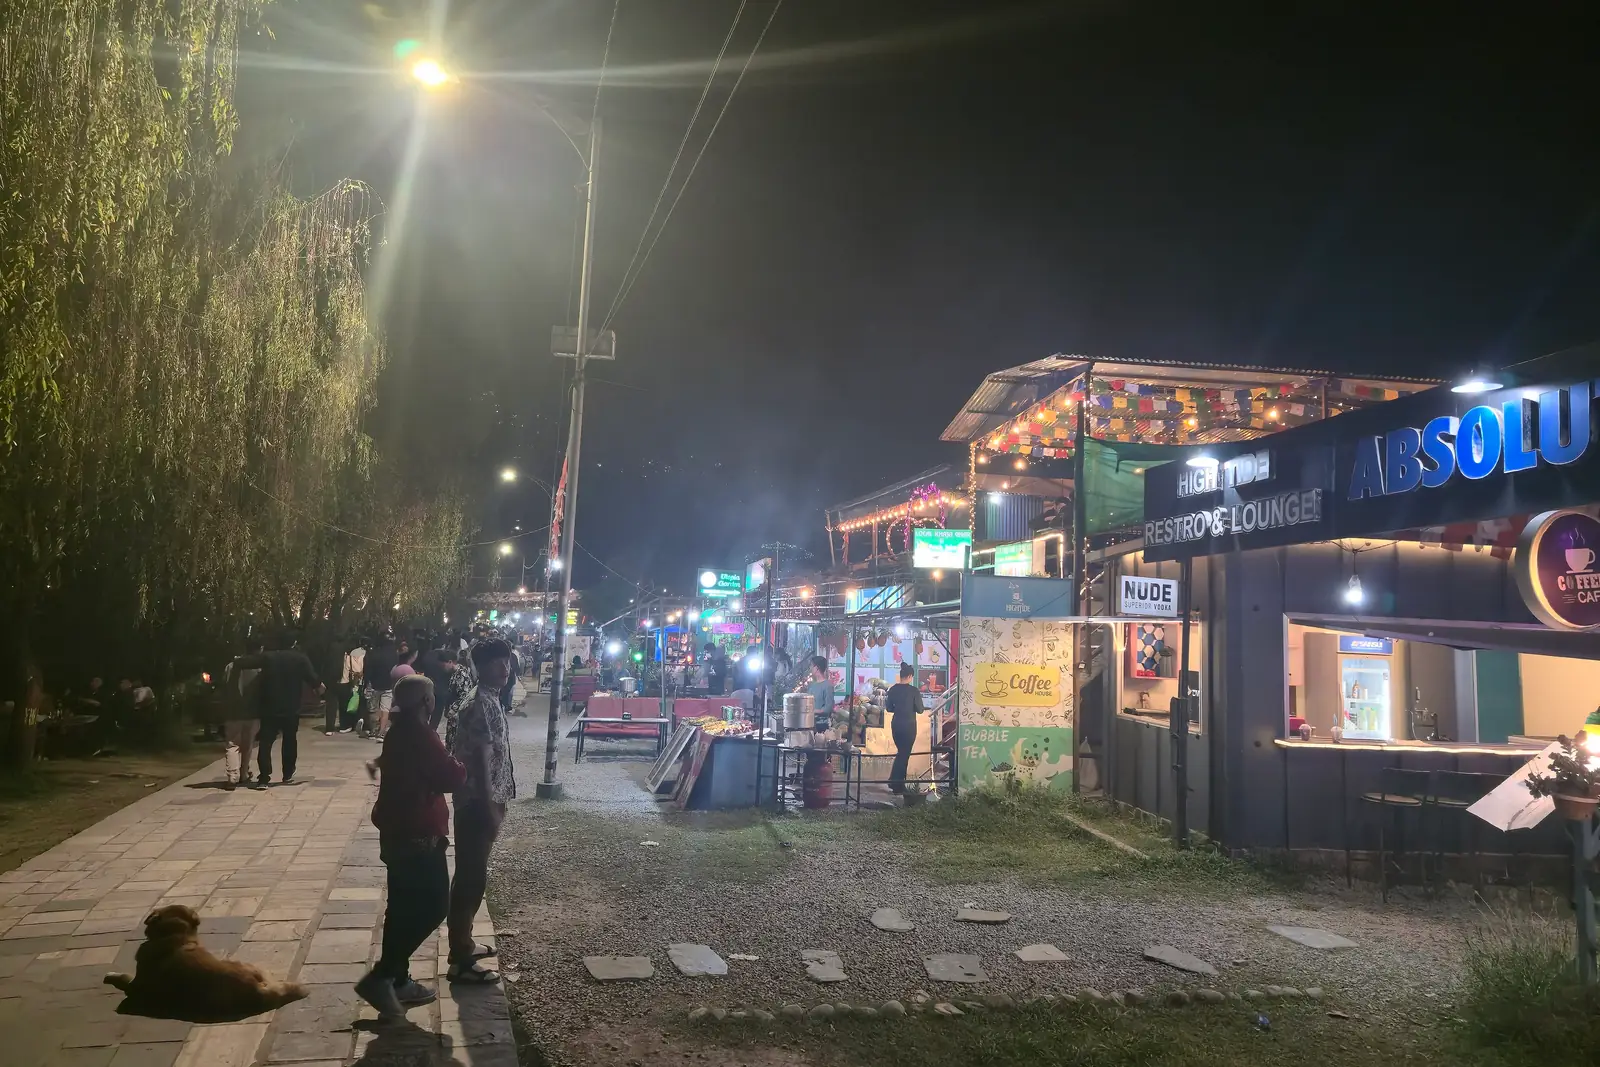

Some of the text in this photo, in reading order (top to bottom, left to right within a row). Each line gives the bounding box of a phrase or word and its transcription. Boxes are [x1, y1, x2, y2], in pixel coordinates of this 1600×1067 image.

[1347, 379, 1600, 501] ABSOLU
[1177, 449, 1271, 498] HIGH TIDE
[1144, 488, 1318, 547] RESTRO & LOUNGE
[1124, 580, 1172, 603] NUDE
[1557, 573, 1600, 591] COFFE
[1124, 601, 1172, 611] SUPERIOR VODKA
[1009, 673, 1052, 694] Coffee
[963, 728, 1010, 742] BUBBLE
[962, 744, 988, 760] TEA
